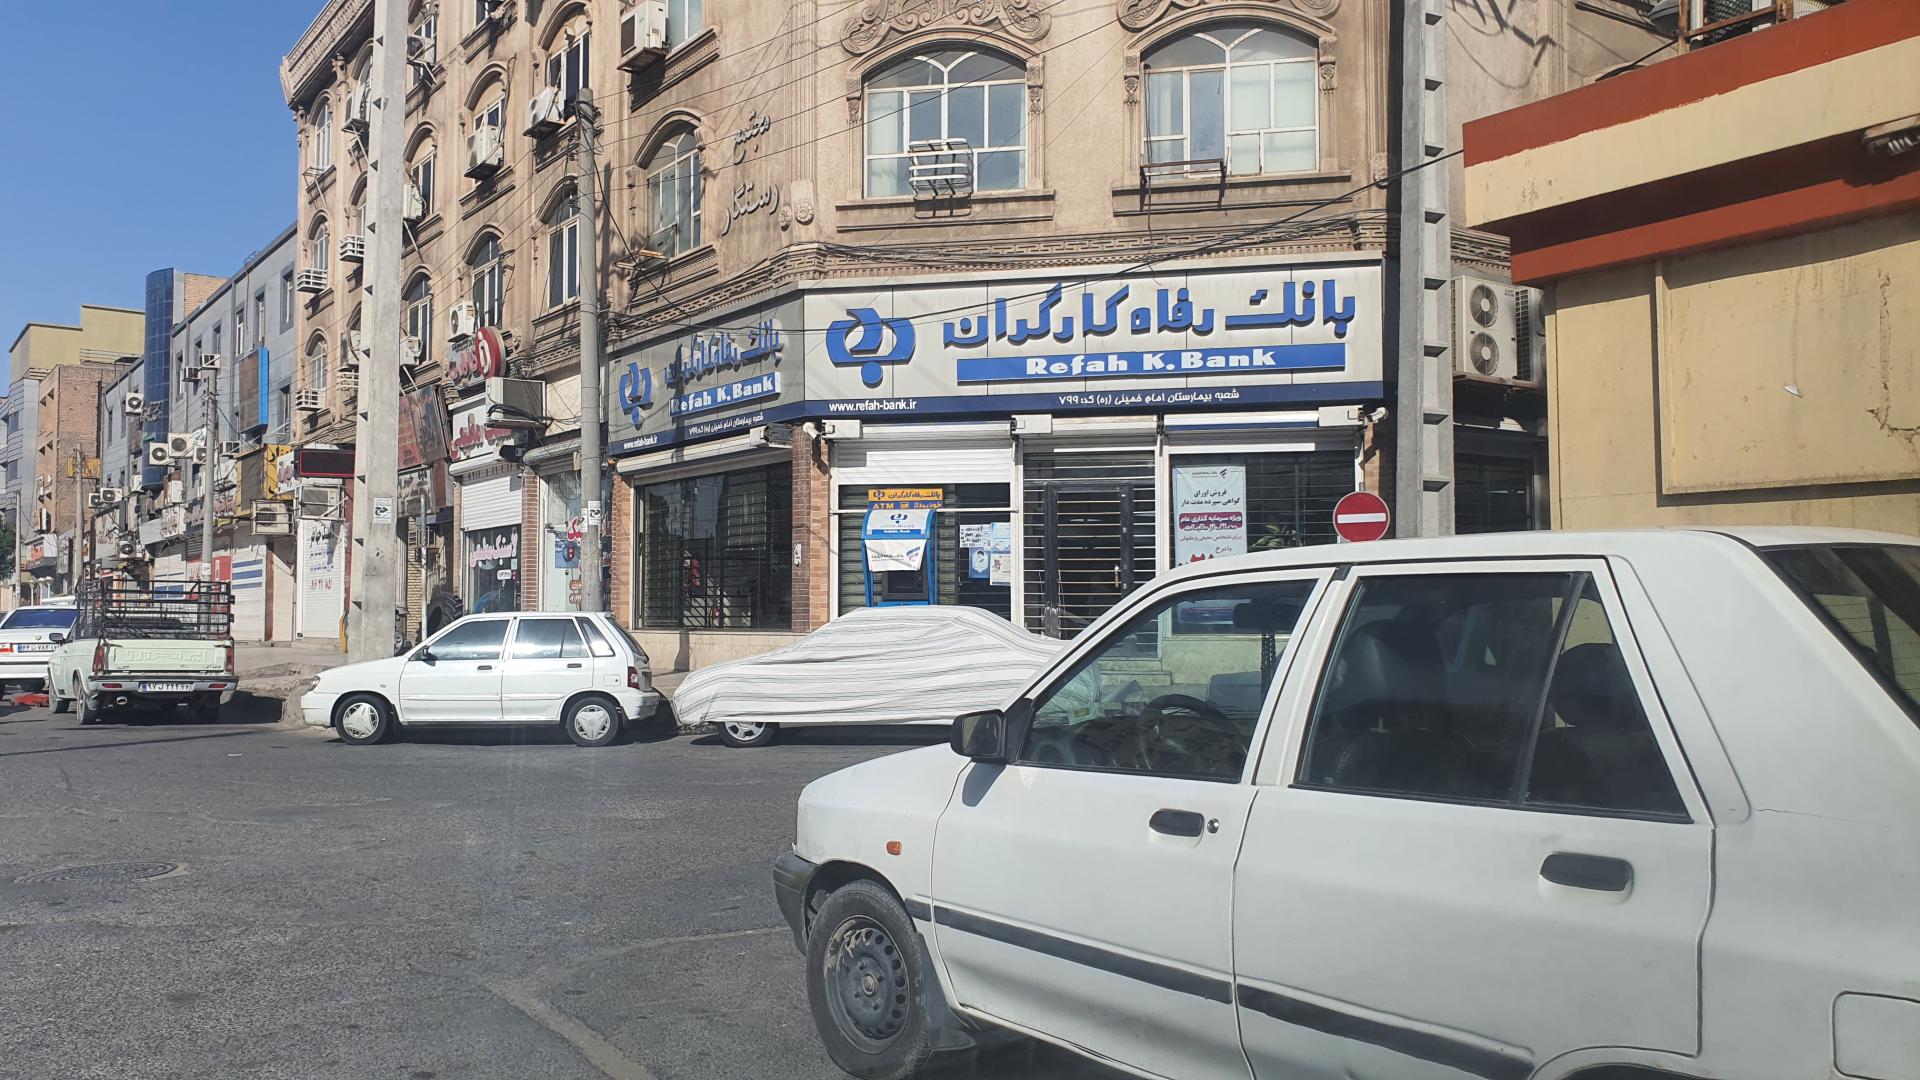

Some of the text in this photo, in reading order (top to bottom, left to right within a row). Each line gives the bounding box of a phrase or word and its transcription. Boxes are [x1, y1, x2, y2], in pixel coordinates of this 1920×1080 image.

[943, 279, 1356, 349] بانک رفاه کارگران
[1026, 347, 1277, 377] Refah K.Bank
[1097, 394, 1112, 406] (ره)
[1115, 394, 1143, 405] خمینی
[1145, 393, 1165, 404] امام
[1167, 391, 1212, 403] بیمارستان
[1215, 388, 1240, 401] شعبه
[671, 391, 712, 412] Refah
[829, 399, 917, 412] www.refah-bank.ir
[1194, 489, 1227, 498] فروش اوراق
[1222, 497, 1241, 506] گواهی
